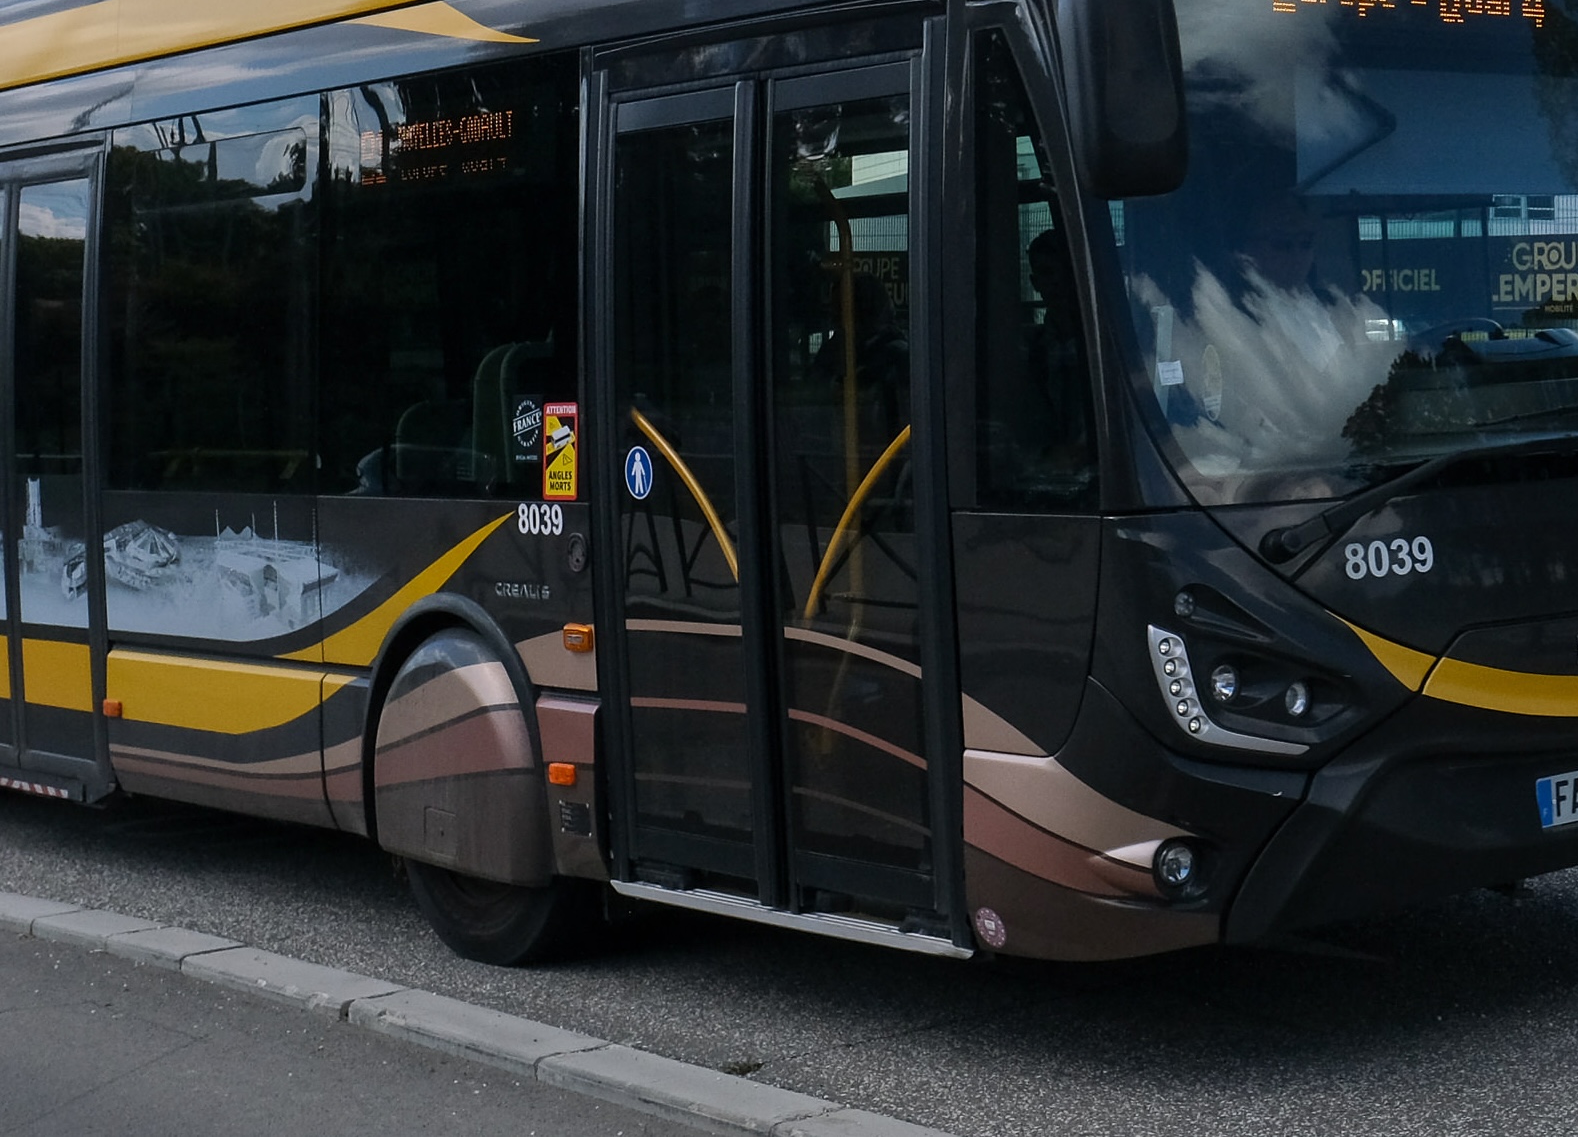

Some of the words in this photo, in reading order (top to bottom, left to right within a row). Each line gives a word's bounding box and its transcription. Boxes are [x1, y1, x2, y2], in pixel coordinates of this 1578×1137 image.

[513, 414, 541, 433] FRANCE
[548, 470, 573, 481] ANGLES
[549, 481, 572, 492] MORTS
[518, 502, 563, 536] 8039
[1344, 535, 1434, 580] 8039
[494, 581, 550, 600] CREALIS
